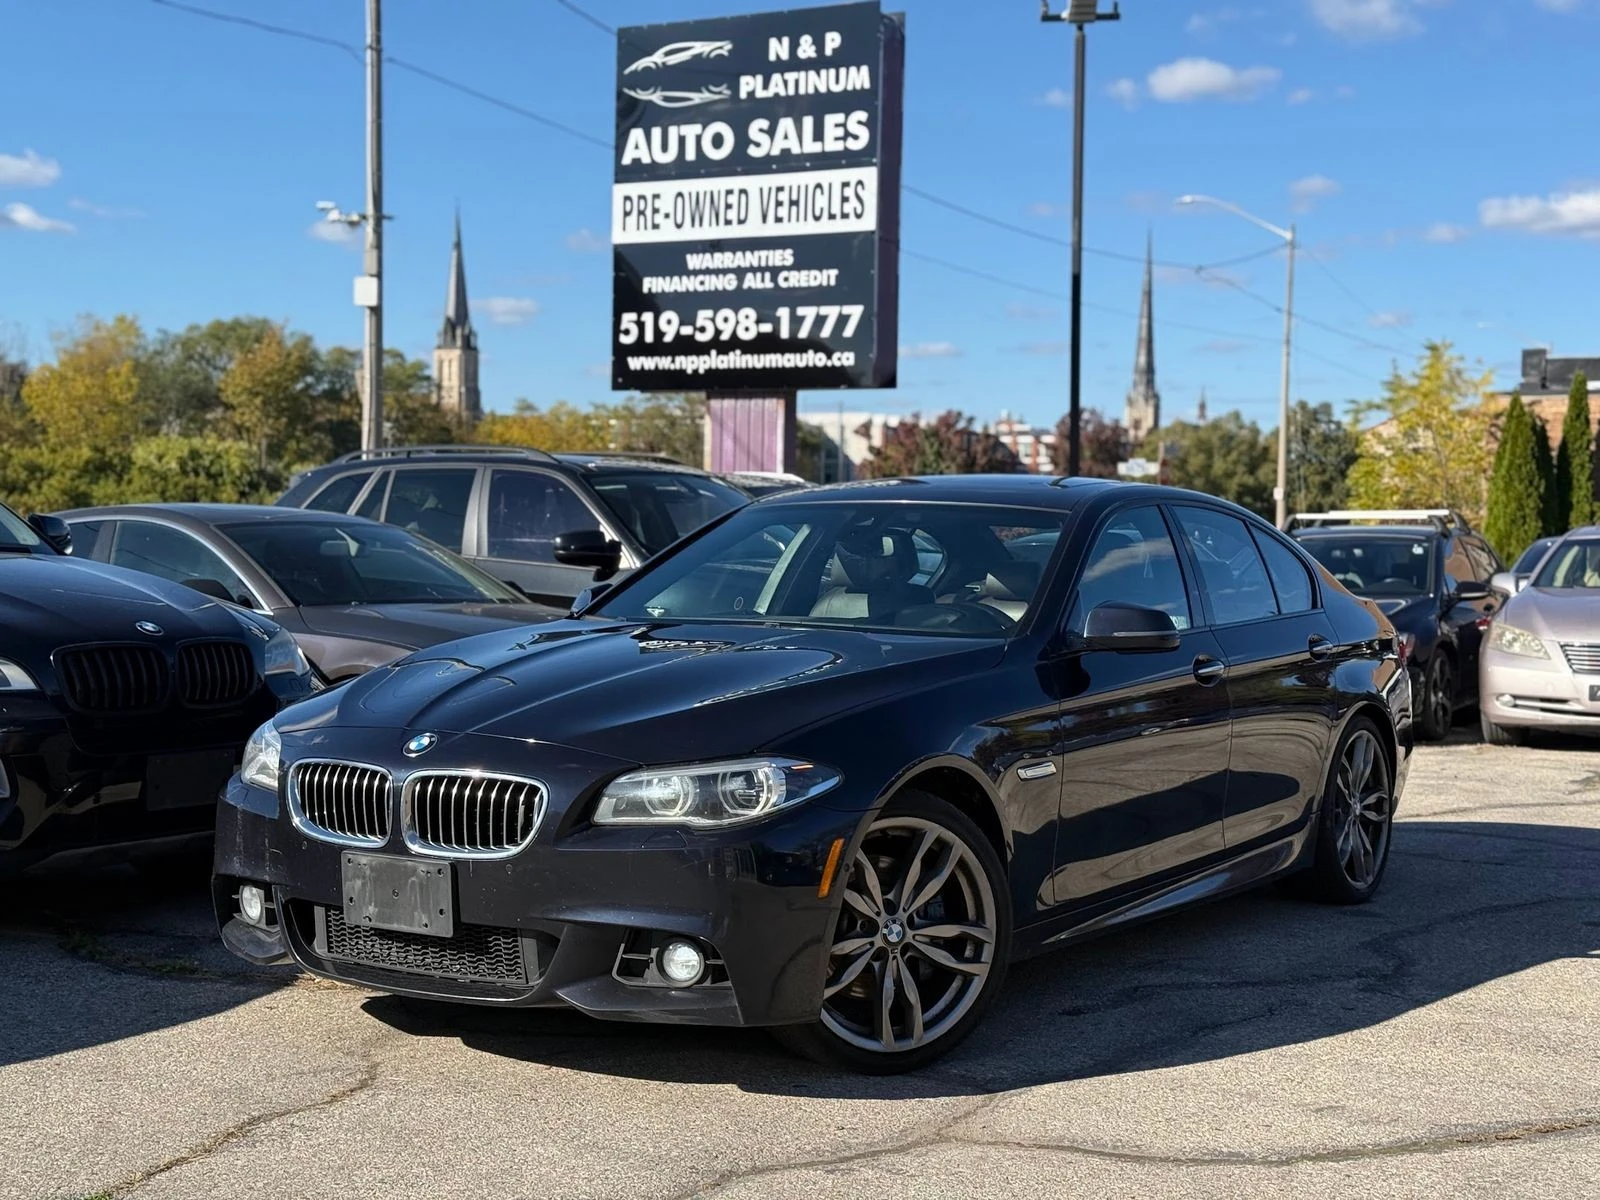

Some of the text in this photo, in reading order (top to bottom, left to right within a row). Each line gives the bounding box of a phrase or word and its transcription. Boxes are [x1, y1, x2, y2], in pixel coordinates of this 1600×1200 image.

[769, 32, 841, 61] N & P
[740, 65, 870, 99] PLATINUM
[621, 111, 869, 165] AUTO SALES
[623, 179, 866, 230] PRE-OWNED VEHICLES
[686, 249, 794, 270] WARRANTIES
[643, 269, 838, 293] FINANCING ALL CREDIT
[619, 305, 864, 344] 519-598-1777
[627, 350, 855, 374] www.npplatinumauto.ca
